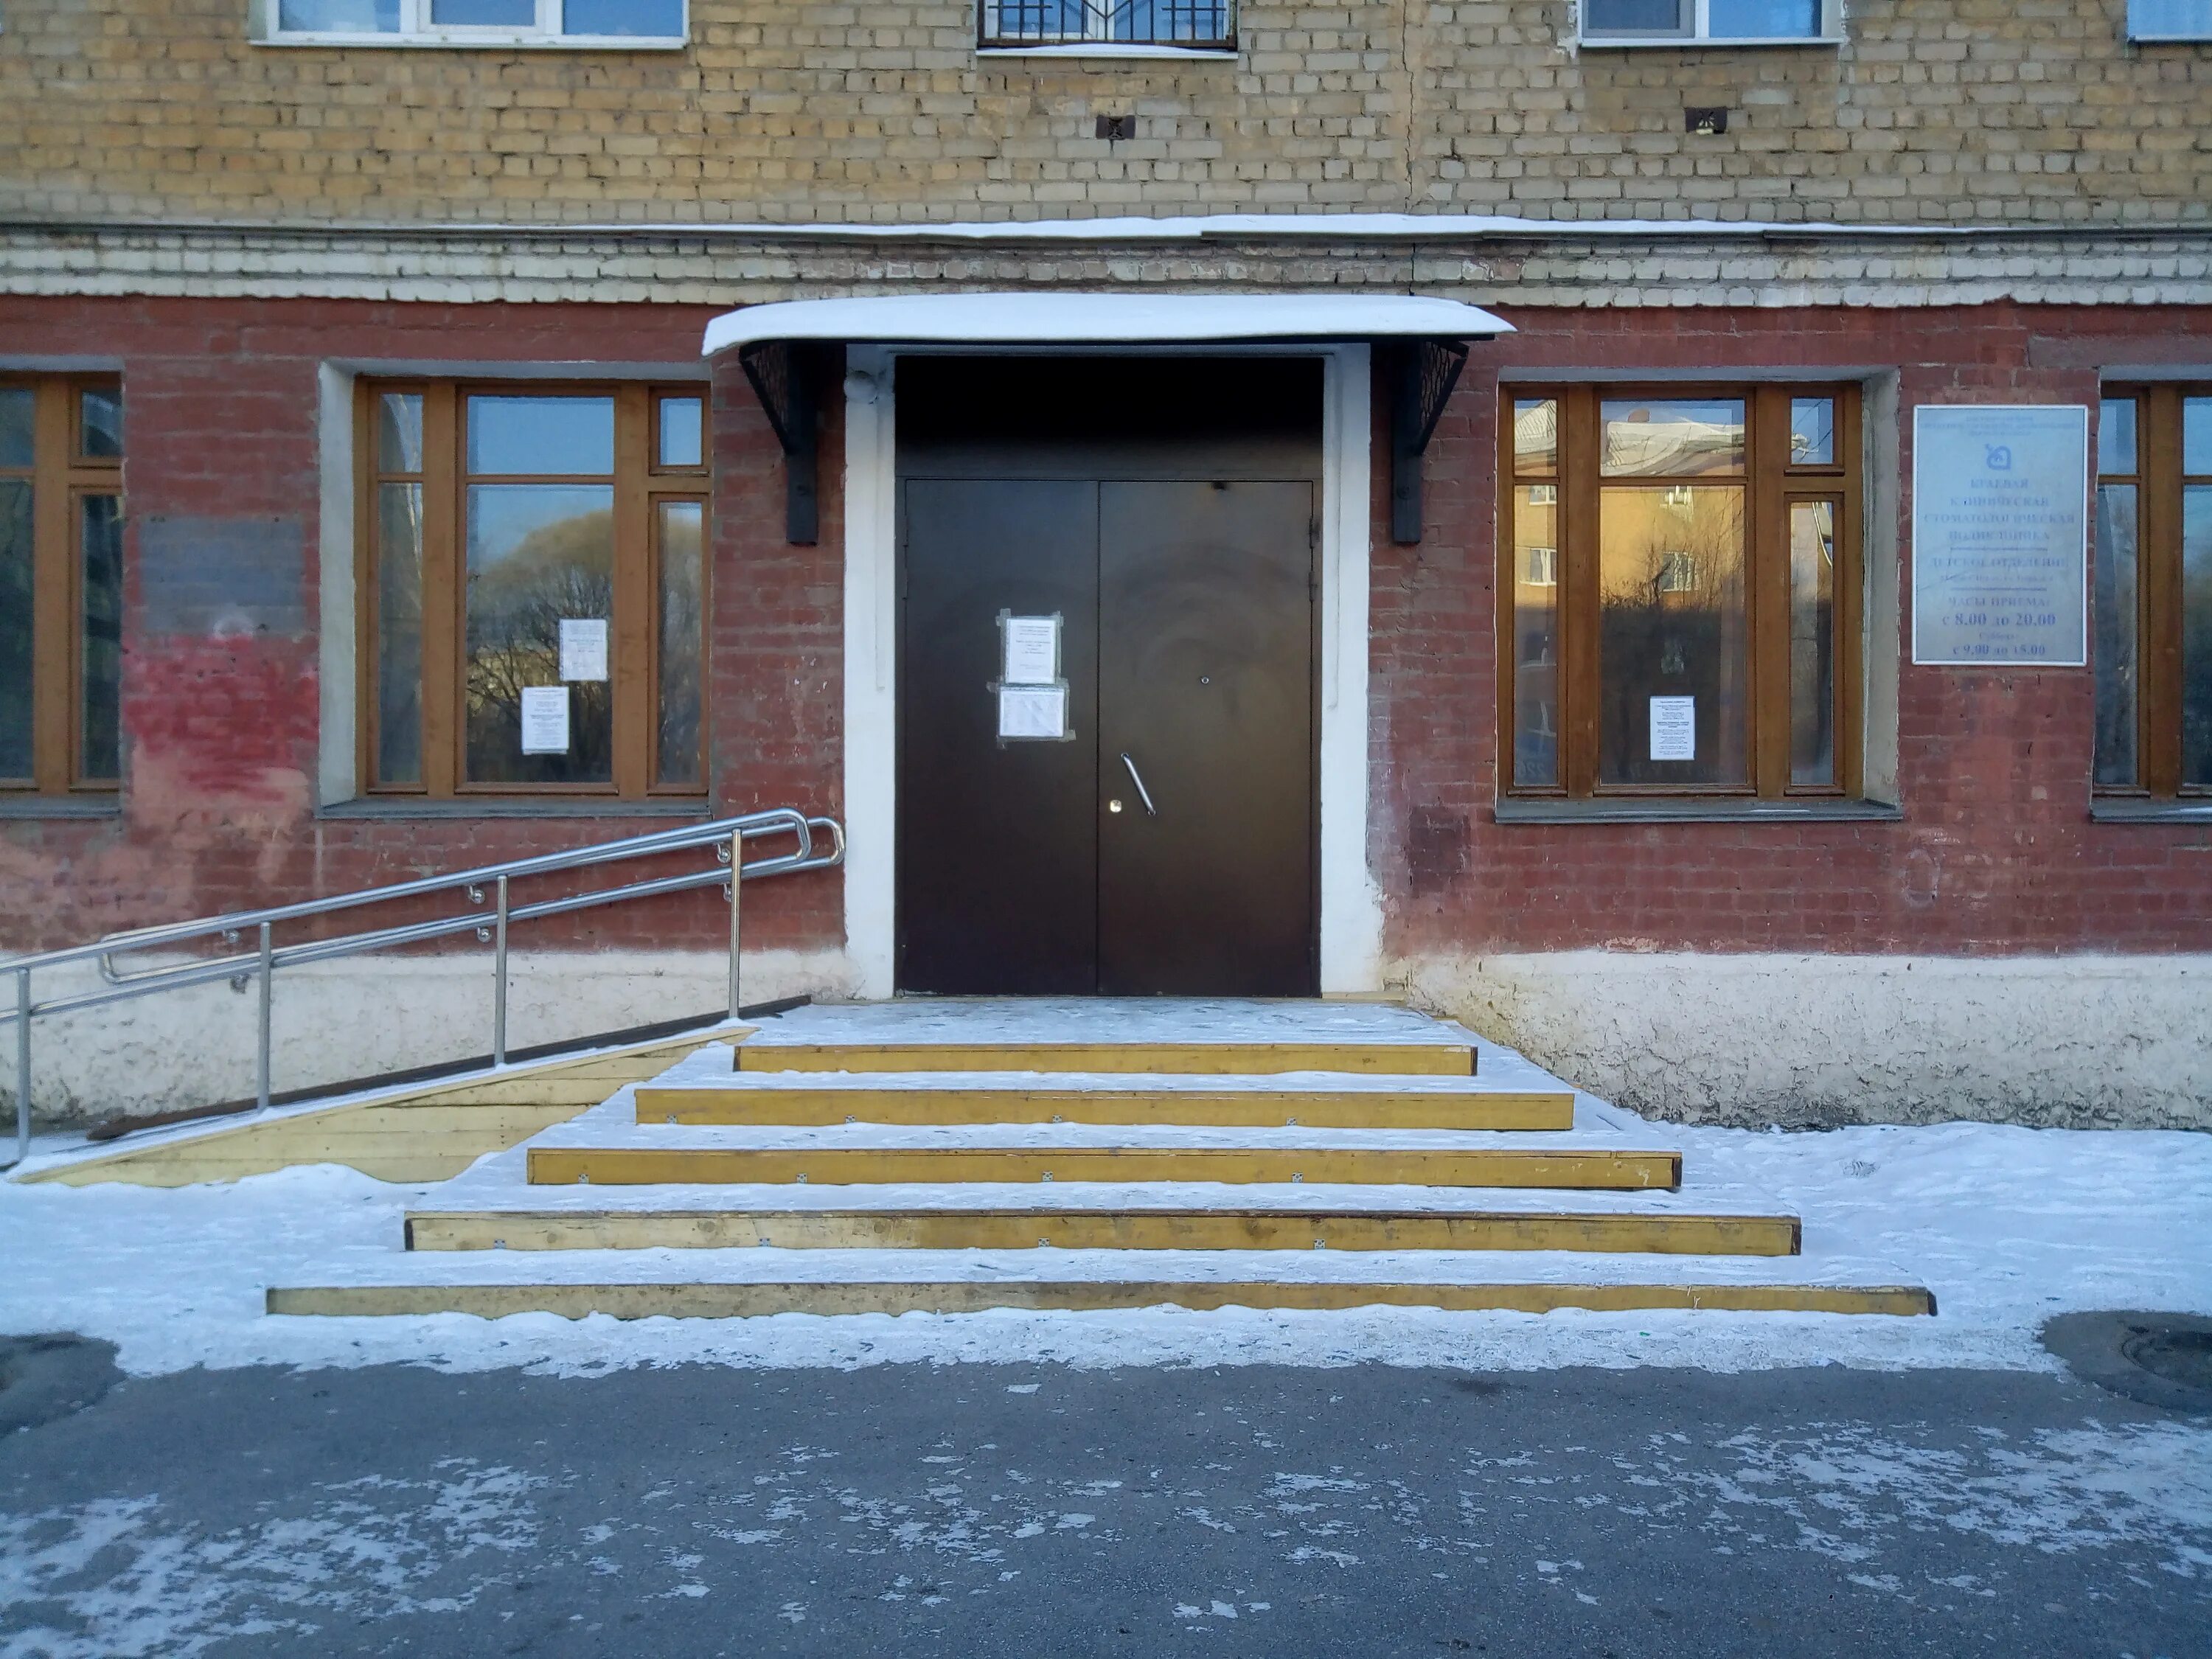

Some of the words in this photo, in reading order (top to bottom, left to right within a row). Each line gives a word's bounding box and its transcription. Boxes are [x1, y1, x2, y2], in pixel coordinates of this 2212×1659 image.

[1970, 479, 2029, 489] КРАЕВАЯ
[1950, 496, 2050, 507] КЛИНИЧЕСКАЯ
[1924, 514, 2075, 524] СТОМАТОЛОГИЧЕСКАЯ
[1948, 530, 2051, 541] ПОЛИКЛИНИКА
[1930, 557, 1985, 567] ДЕТСКОЕ
[1992, 557, 2067, 567] ОТДЕЛЕНИЕ
[1947, 597, 1986, 607] ЧАСЫ
[1942, 615, 1950, 626] с
[1954, 613, 1987, 626] 8.00
[1993, 616, 2009, 627] до
[2014, 613, 2056, 627] 20.00
[1952, 646, 1961, 655] с
[1963, 644, 1989, 655] 9.00
[1994, 647, 2008, 656] до
[2013, 644, 2046, 655] 15.00
